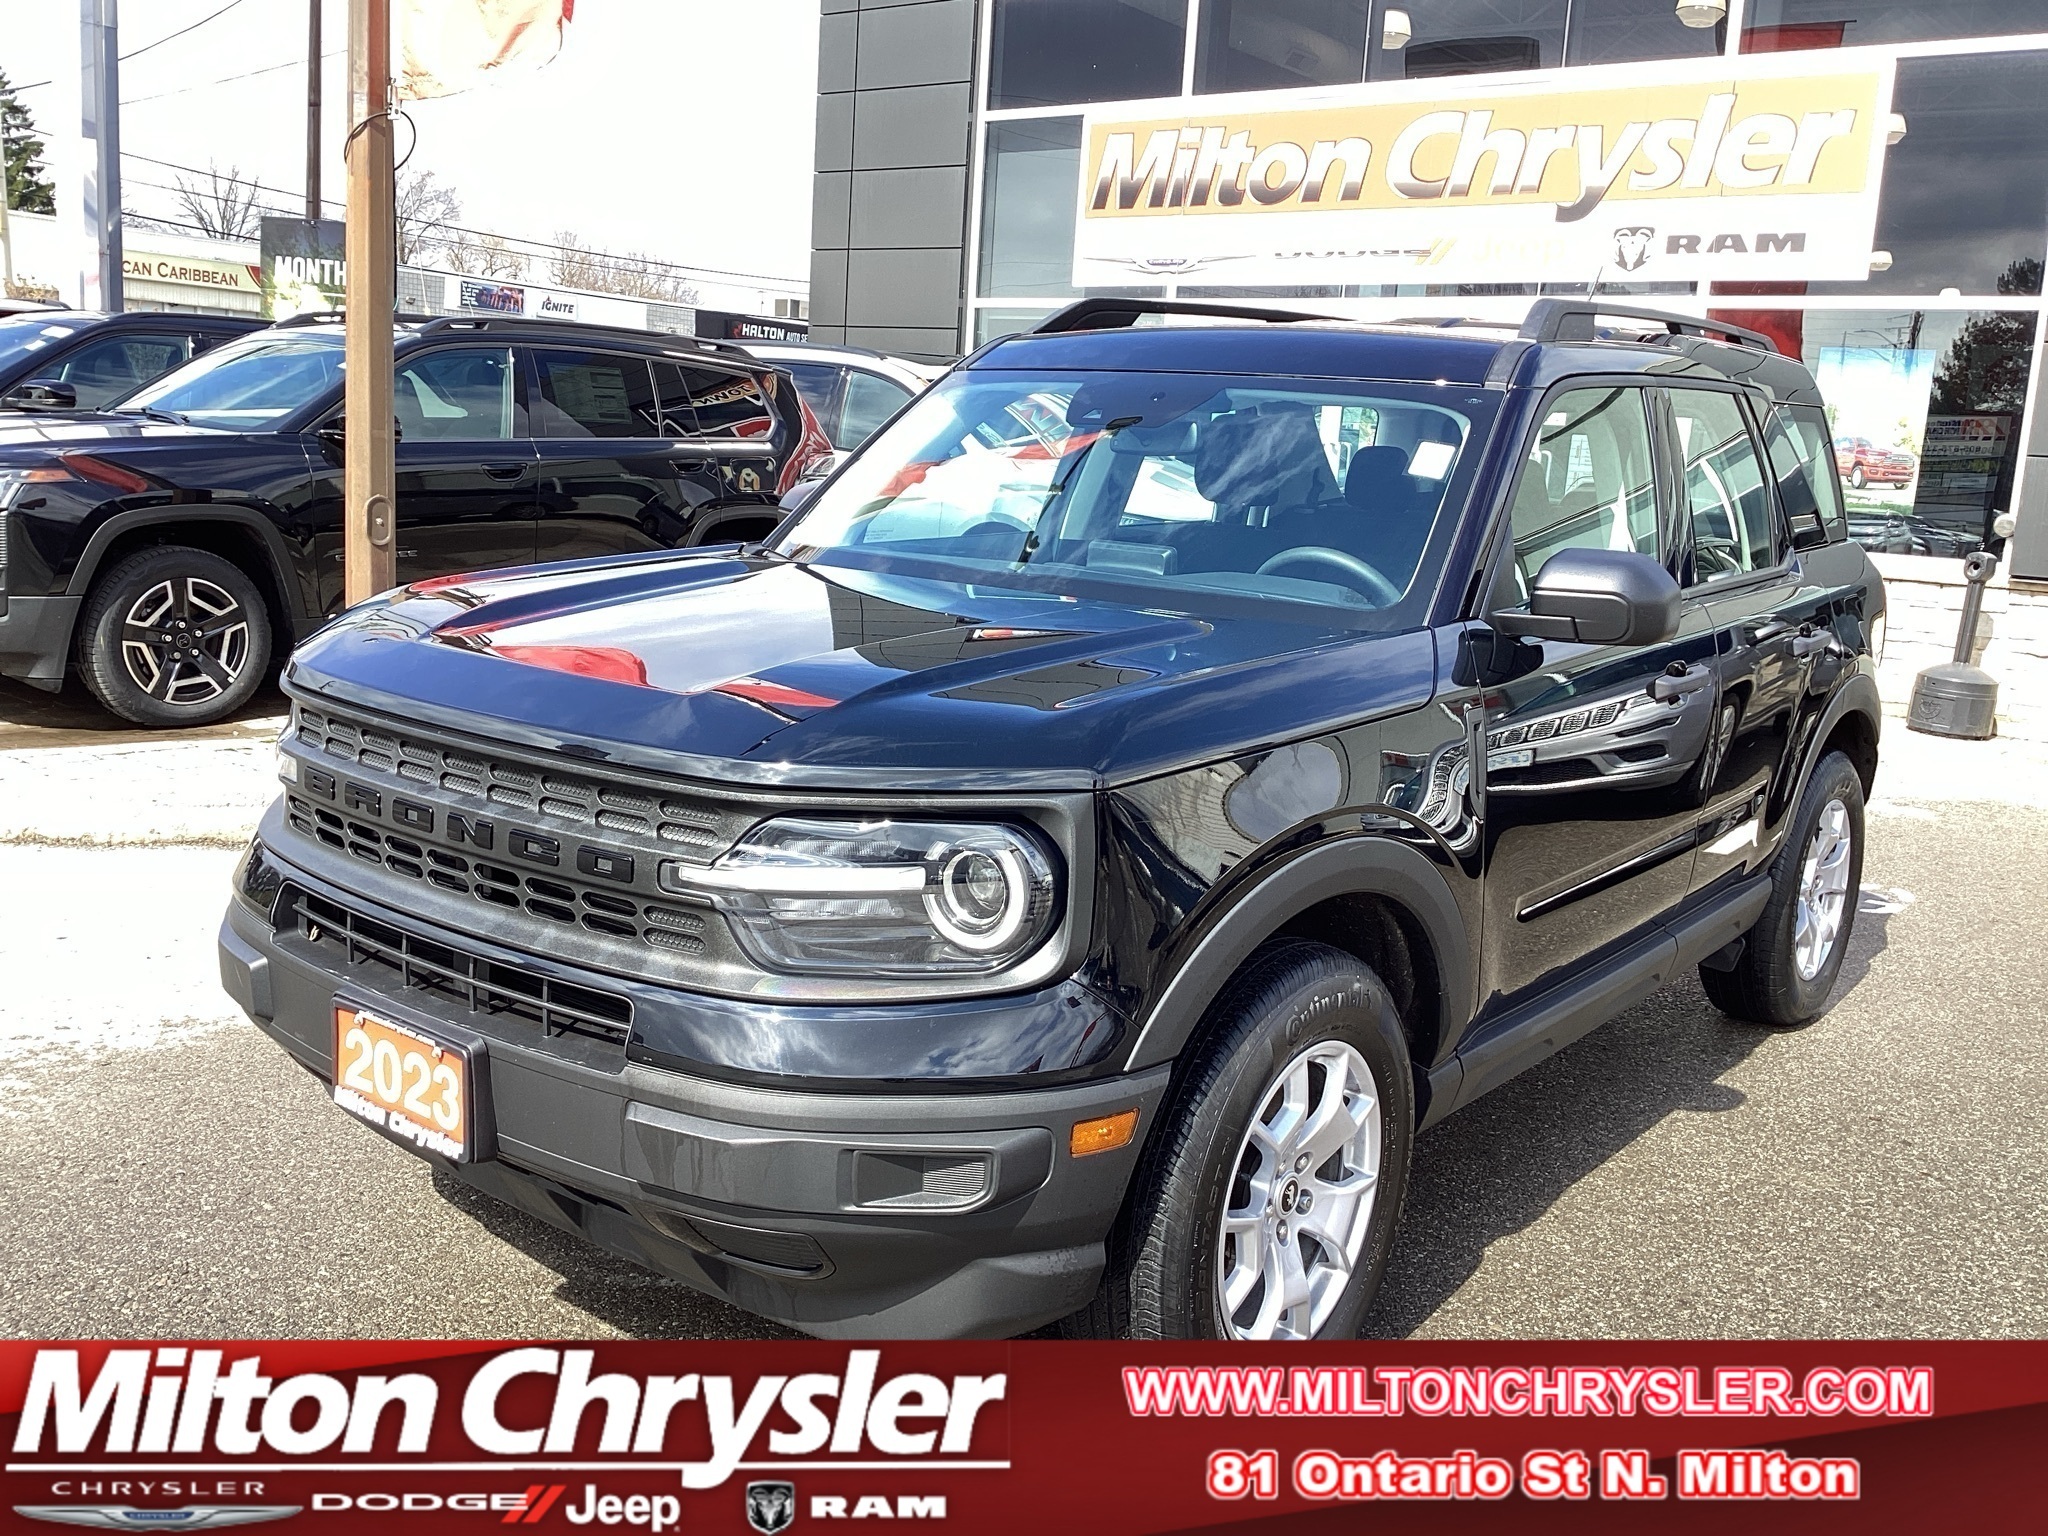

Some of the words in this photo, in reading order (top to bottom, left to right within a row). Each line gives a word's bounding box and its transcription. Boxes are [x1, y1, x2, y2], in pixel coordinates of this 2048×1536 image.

[1090, 125, 1373, 210] Milton
[1384, 93, 1858, 223] Chrysler
[1665, 232, 1807, 254] RAM
[157, 262, 239, 287] CARIBBEAN
[274, 255, 346, 286] MONTH
[541, 300, 575, 314] IGNITE
[741, 323, 786, 341] HALTON
[304, 765, 636, 884] BRONCO
[344, 1028, 460, 1131] 2023
